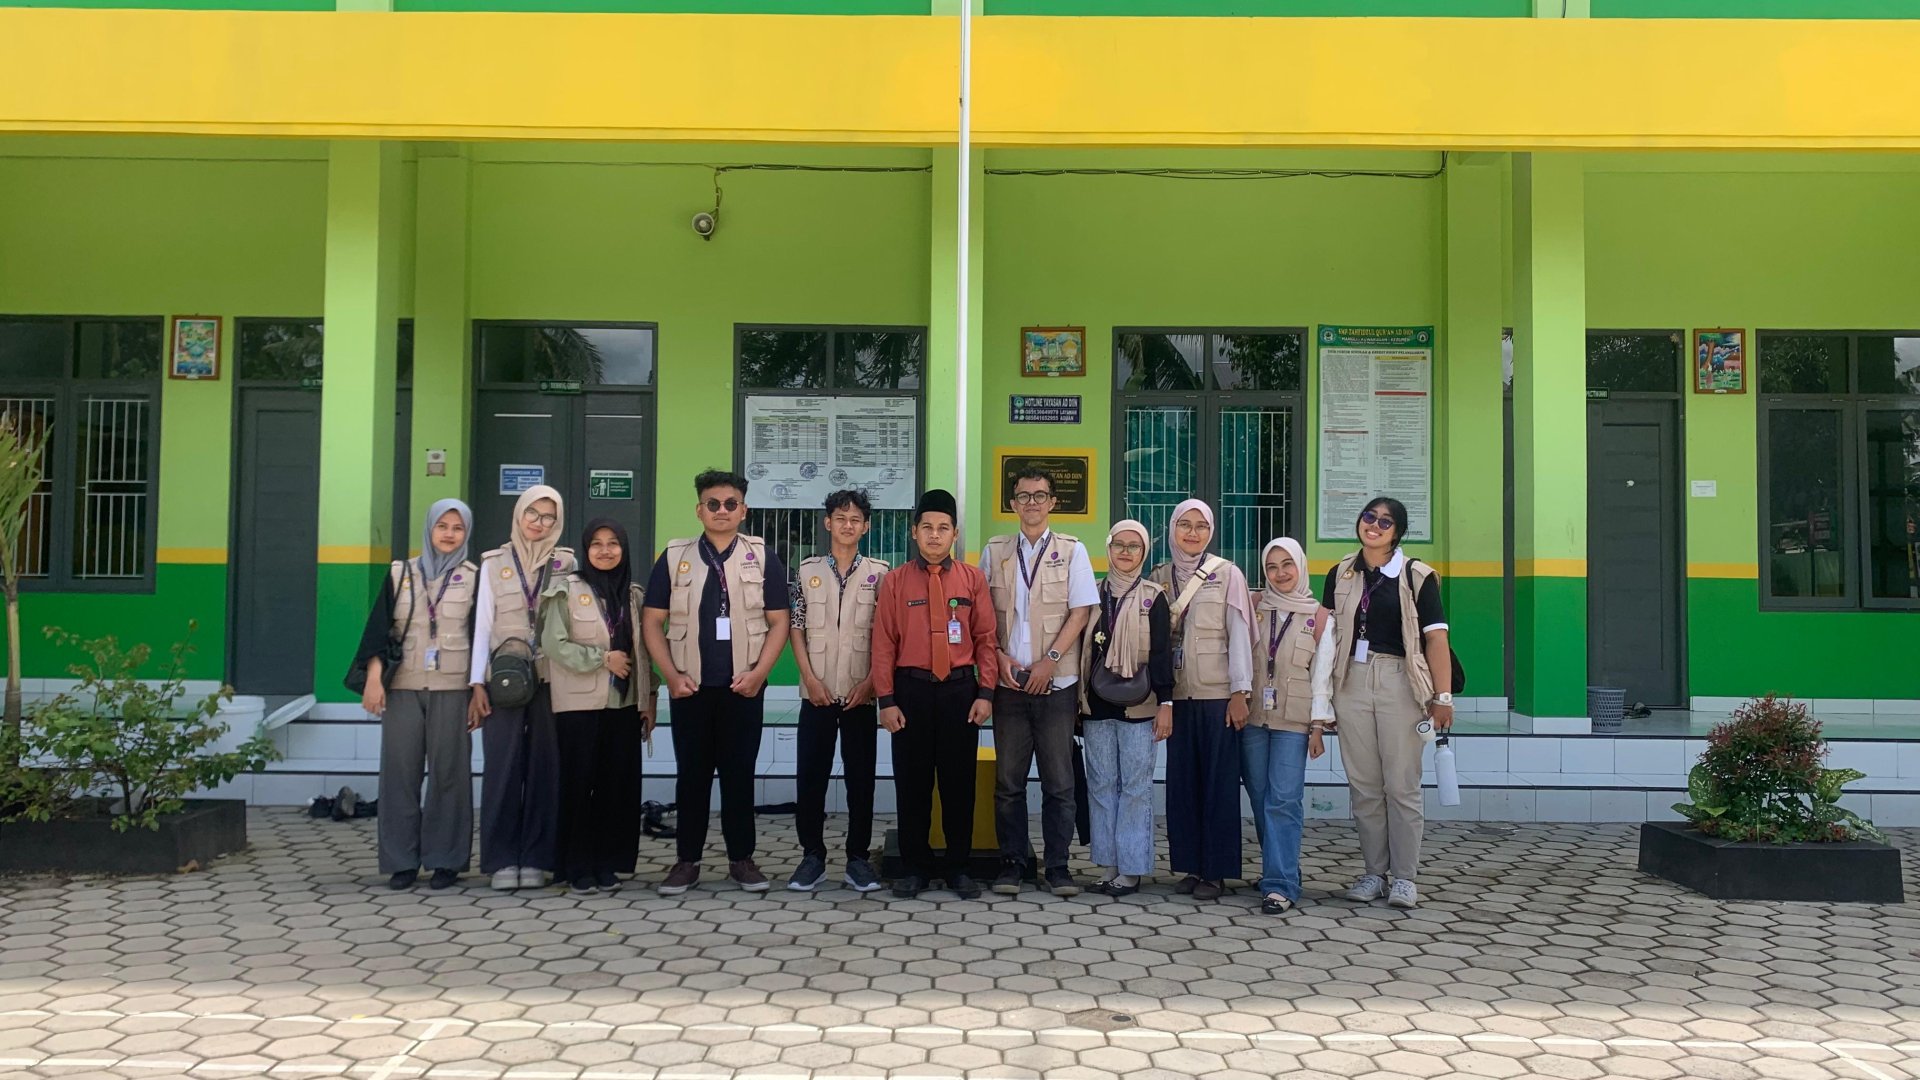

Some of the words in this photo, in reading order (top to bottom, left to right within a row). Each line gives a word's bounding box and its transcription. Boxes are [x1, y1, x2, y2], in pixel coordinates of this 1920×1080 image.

[1025, 398, 1043, 407] HOTLINE
[1043, 398, 1062, 407] YAYASAN
[1062, 399, 1068, 407] AD
